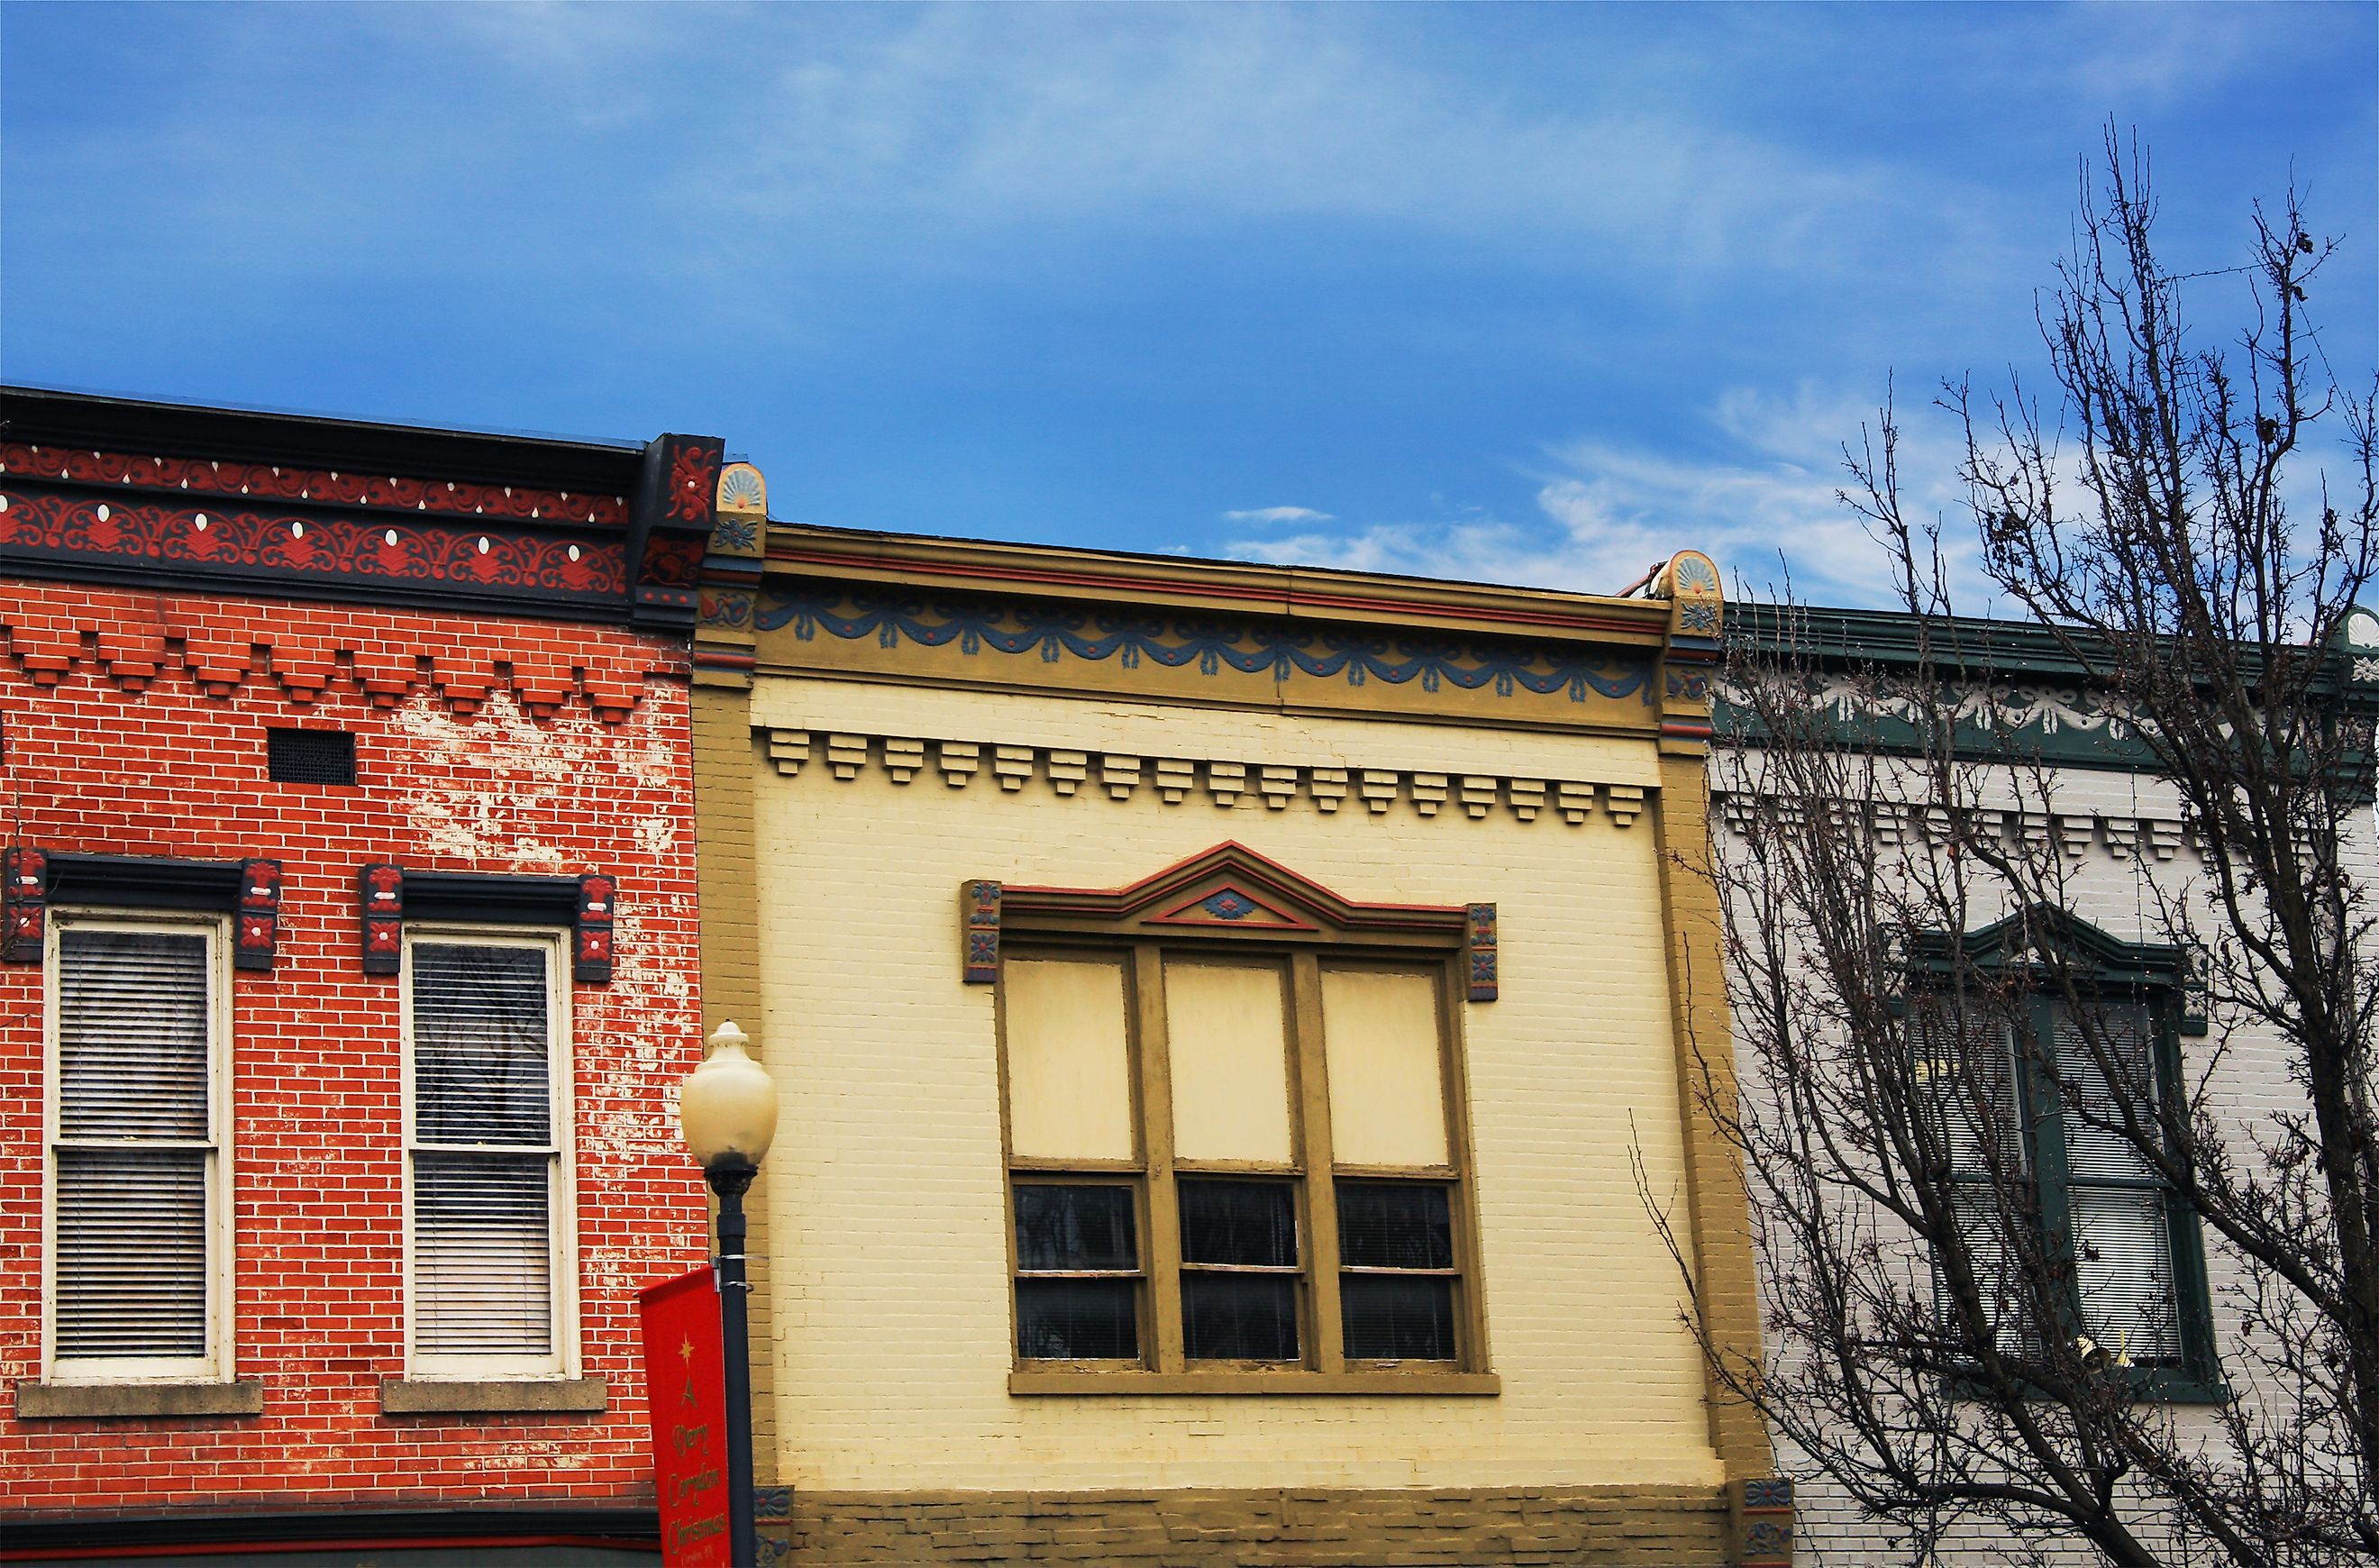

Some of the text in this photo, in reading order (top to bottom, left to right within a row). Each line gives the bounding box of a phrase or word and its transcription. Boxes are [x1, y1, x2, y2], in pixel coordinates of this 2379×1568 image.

[680, 1374, 698, 1408] A
[672, 1424, 708, 1456] Very
[669, 1463, 720, 1507] Corydon
[669, 1513, 725, 1554] Christmas
